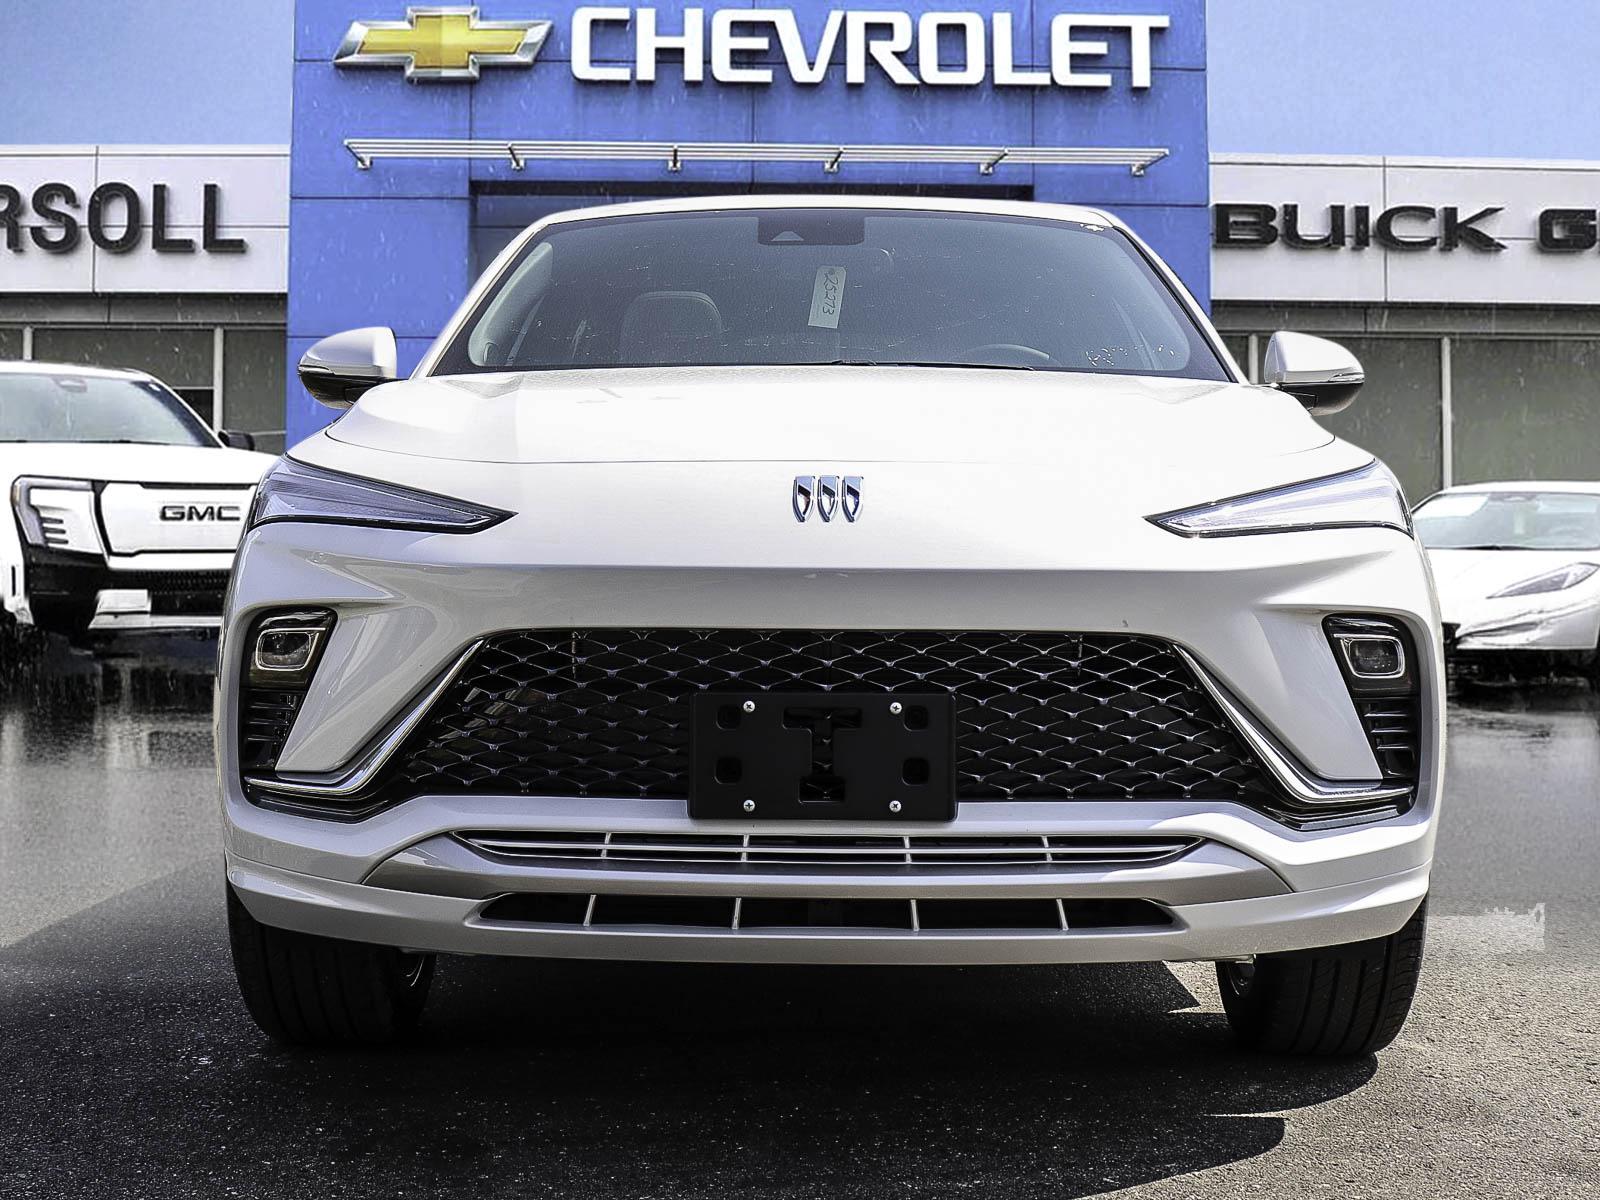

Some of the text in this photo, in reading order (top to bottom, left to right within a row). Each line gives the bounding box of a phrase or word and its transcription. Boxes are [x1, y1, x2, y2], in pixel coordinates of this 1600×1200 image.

[571, 7, 1170, 89] CHEVROLET
[1213, 203, 1507, 251] BUICK
[159, 505, 241, 521] GMC
